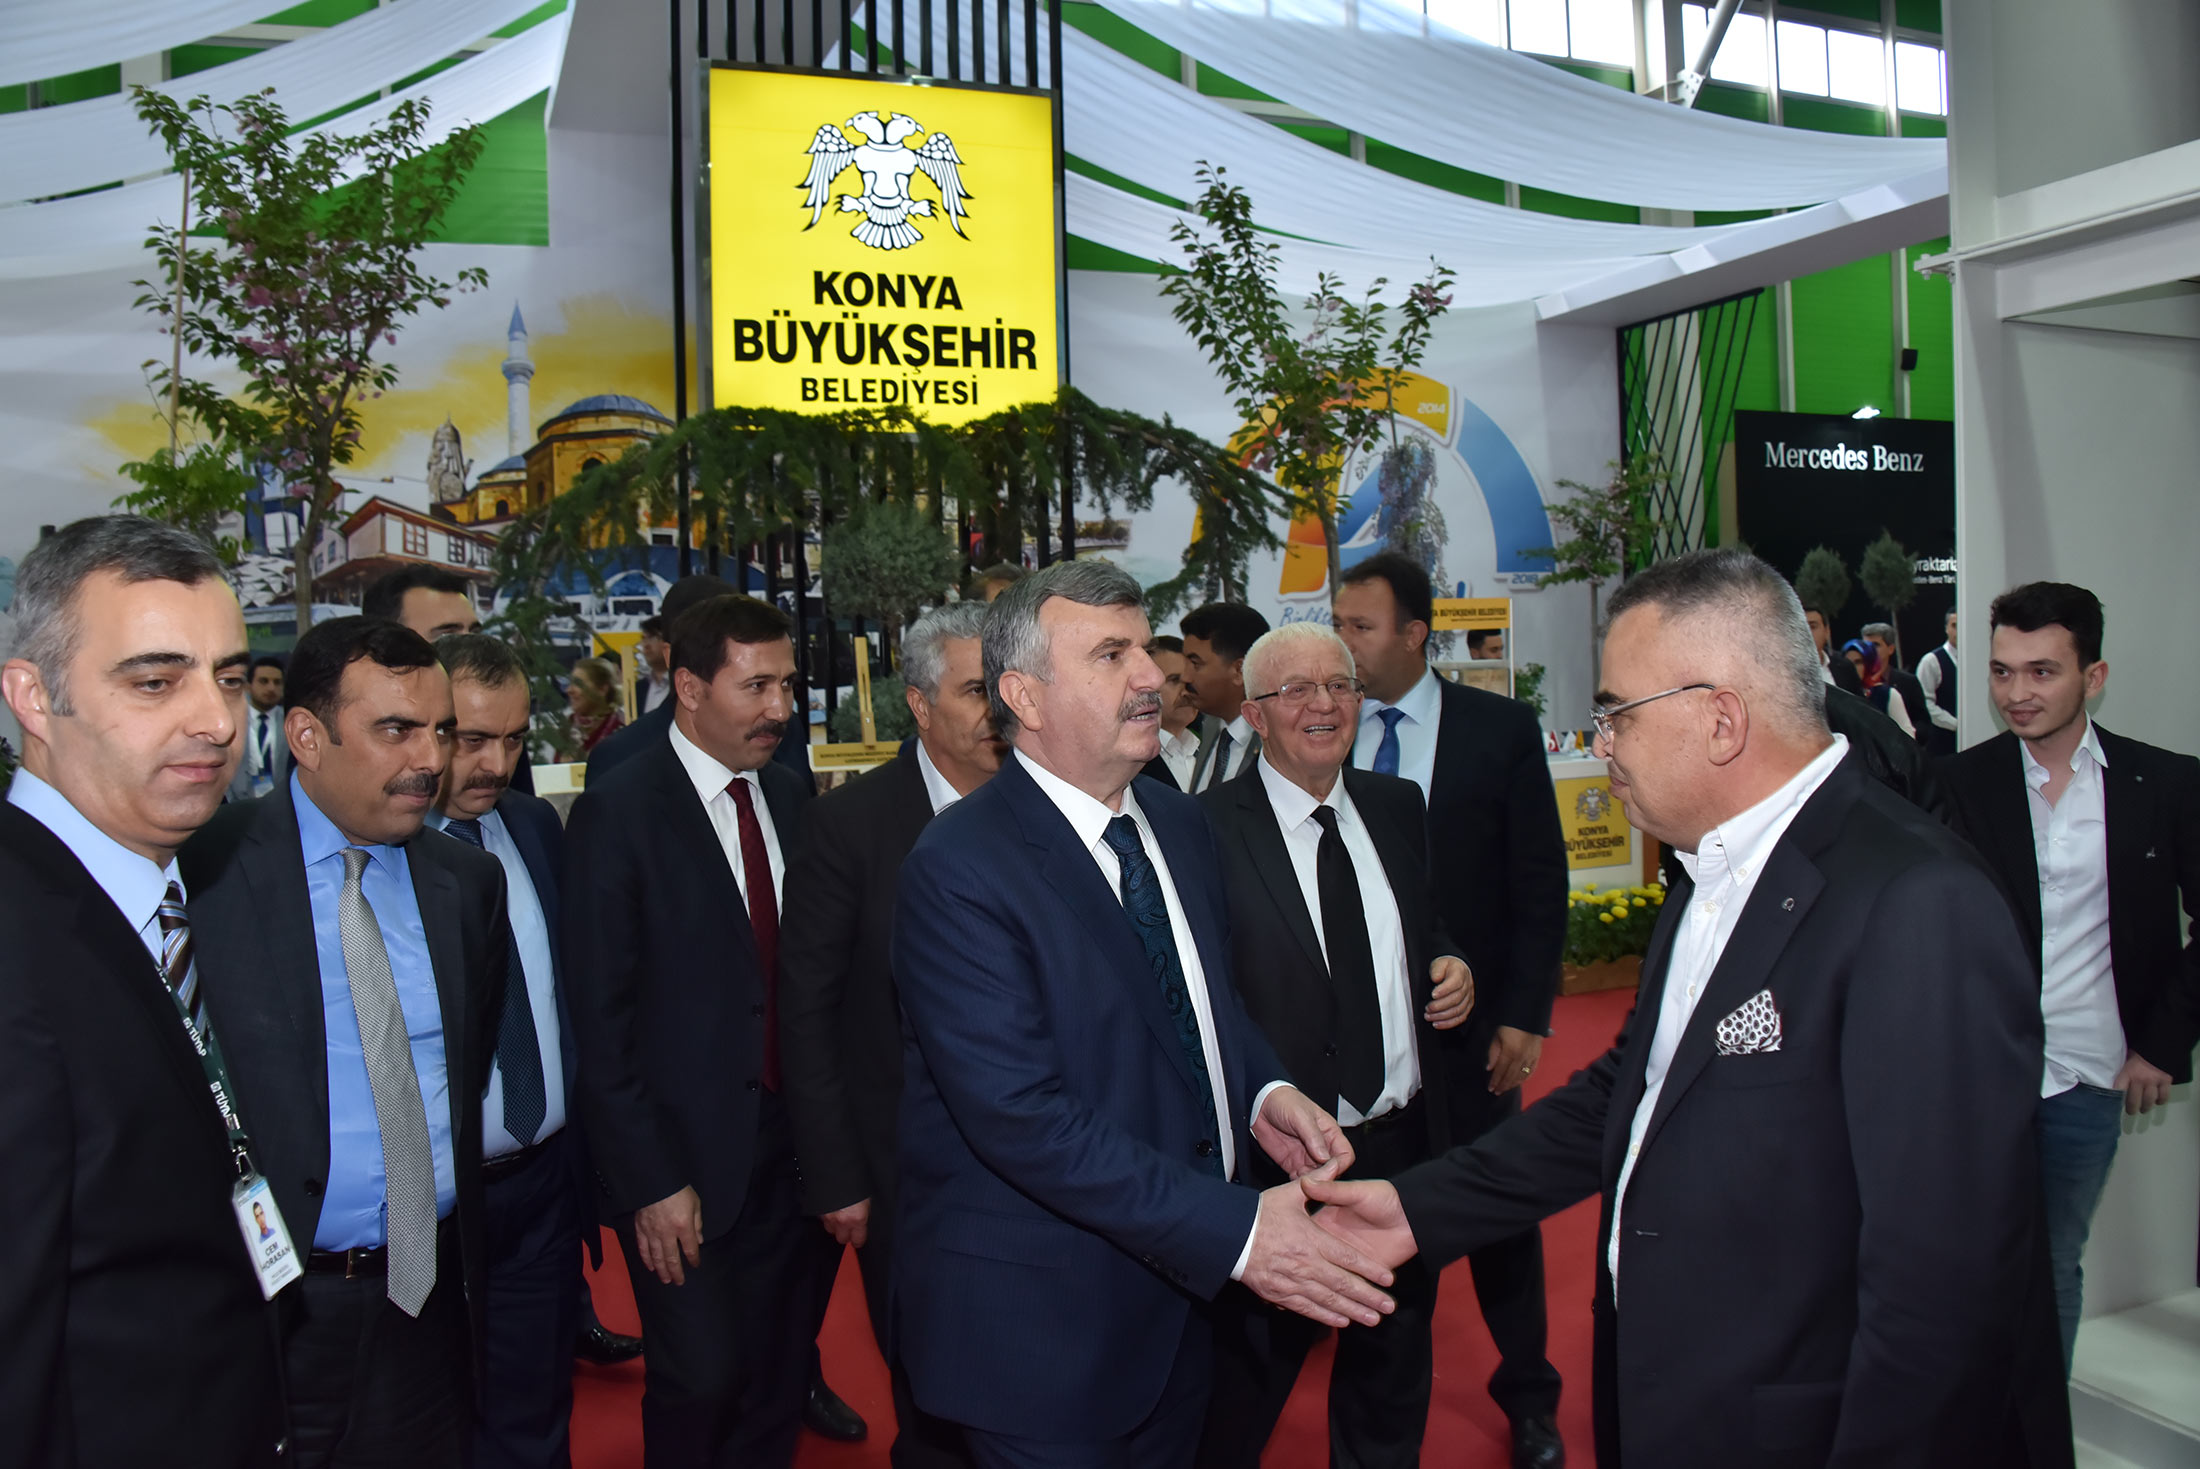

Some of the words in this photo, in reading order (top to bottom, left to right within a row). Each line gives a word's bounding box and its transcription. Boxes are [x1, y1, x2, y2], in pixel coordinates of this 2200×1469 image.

[813, 271, 963, 310] KONYA
[733, 309, 1038, 374] BÜYÜKŞEHİR
[800, 372, 979, 406] BELEDİYESİ
[1417, 402, 1446, 414] 2014
[1764, 442, 1869, 471] Mercedes
[1872, 444, 1925, 473] Benz
[1578, 825, 1609, 836] KONYA
[214, 1089, 232, 1120] TÜYA
[264, 1241, 280, 1257] CEM
